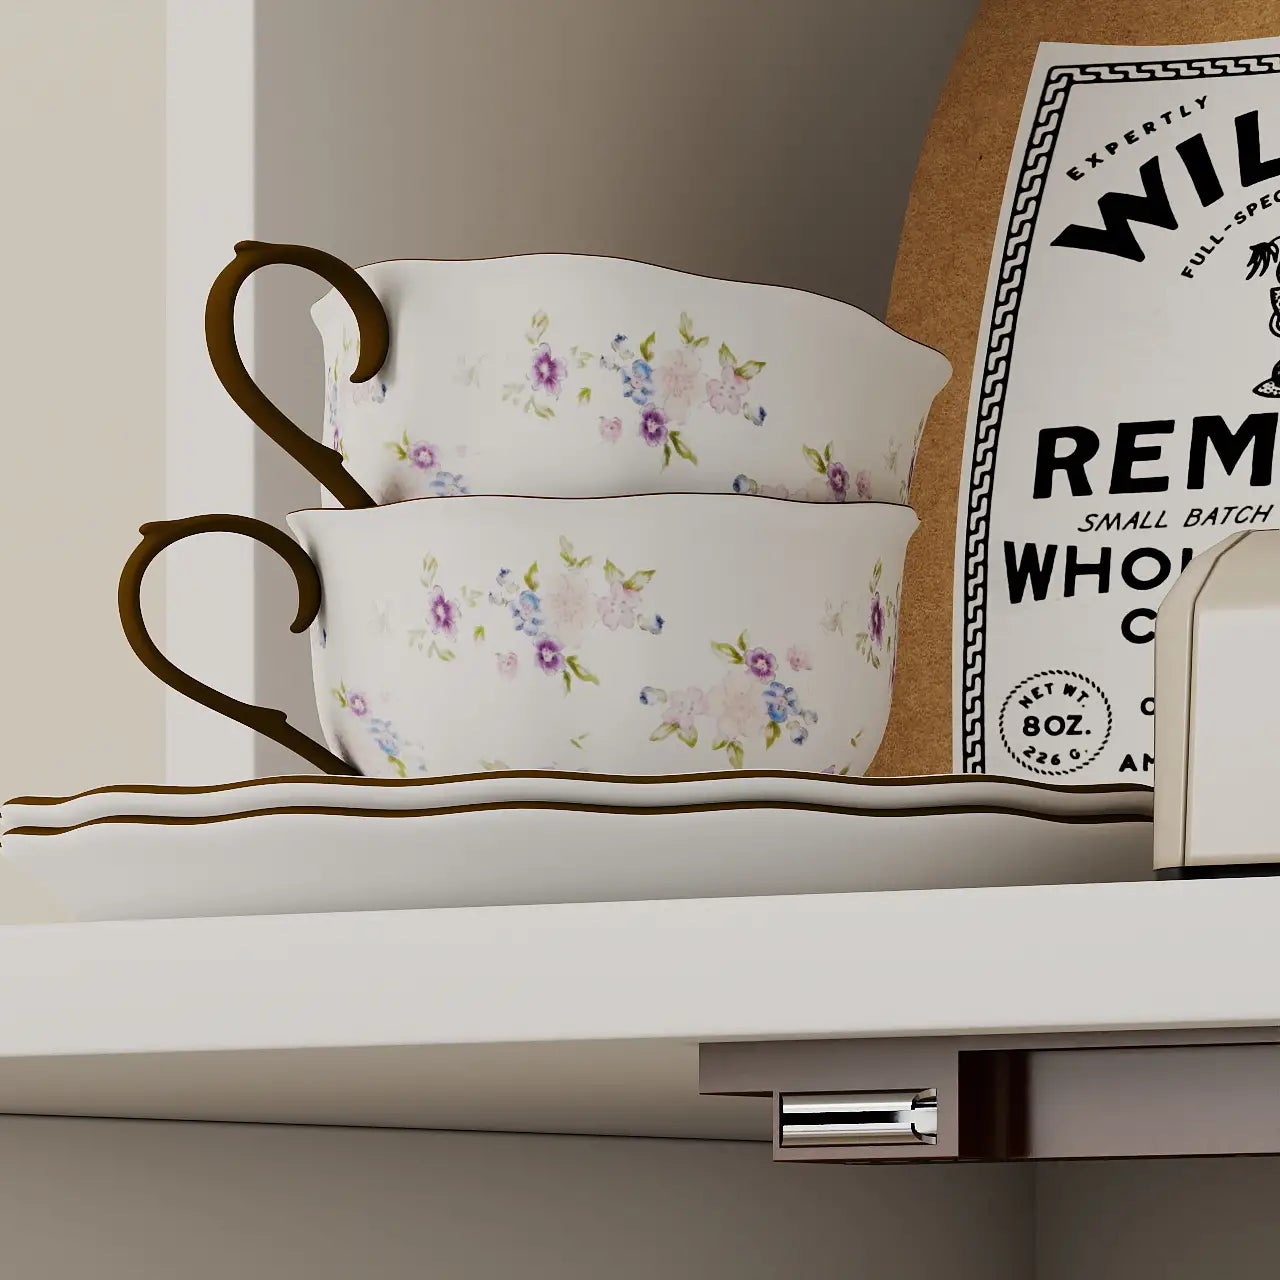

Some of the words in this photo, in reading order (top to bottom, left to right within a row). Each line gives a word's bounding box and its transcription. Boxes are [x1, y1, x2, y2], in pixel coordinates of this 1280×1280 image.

[1066, 95, 1207, 181] EXPERTLY
[1032, 412, 1279, 499] REM
[1077, 510, 1168, 532] SMALL
[1183, 504, 1274, 528] BATCH
[1019, 683, 1053, 709] NET
[1063, 683, 1089, 708] WT.
[1023, 745, 1060, 766] 226
